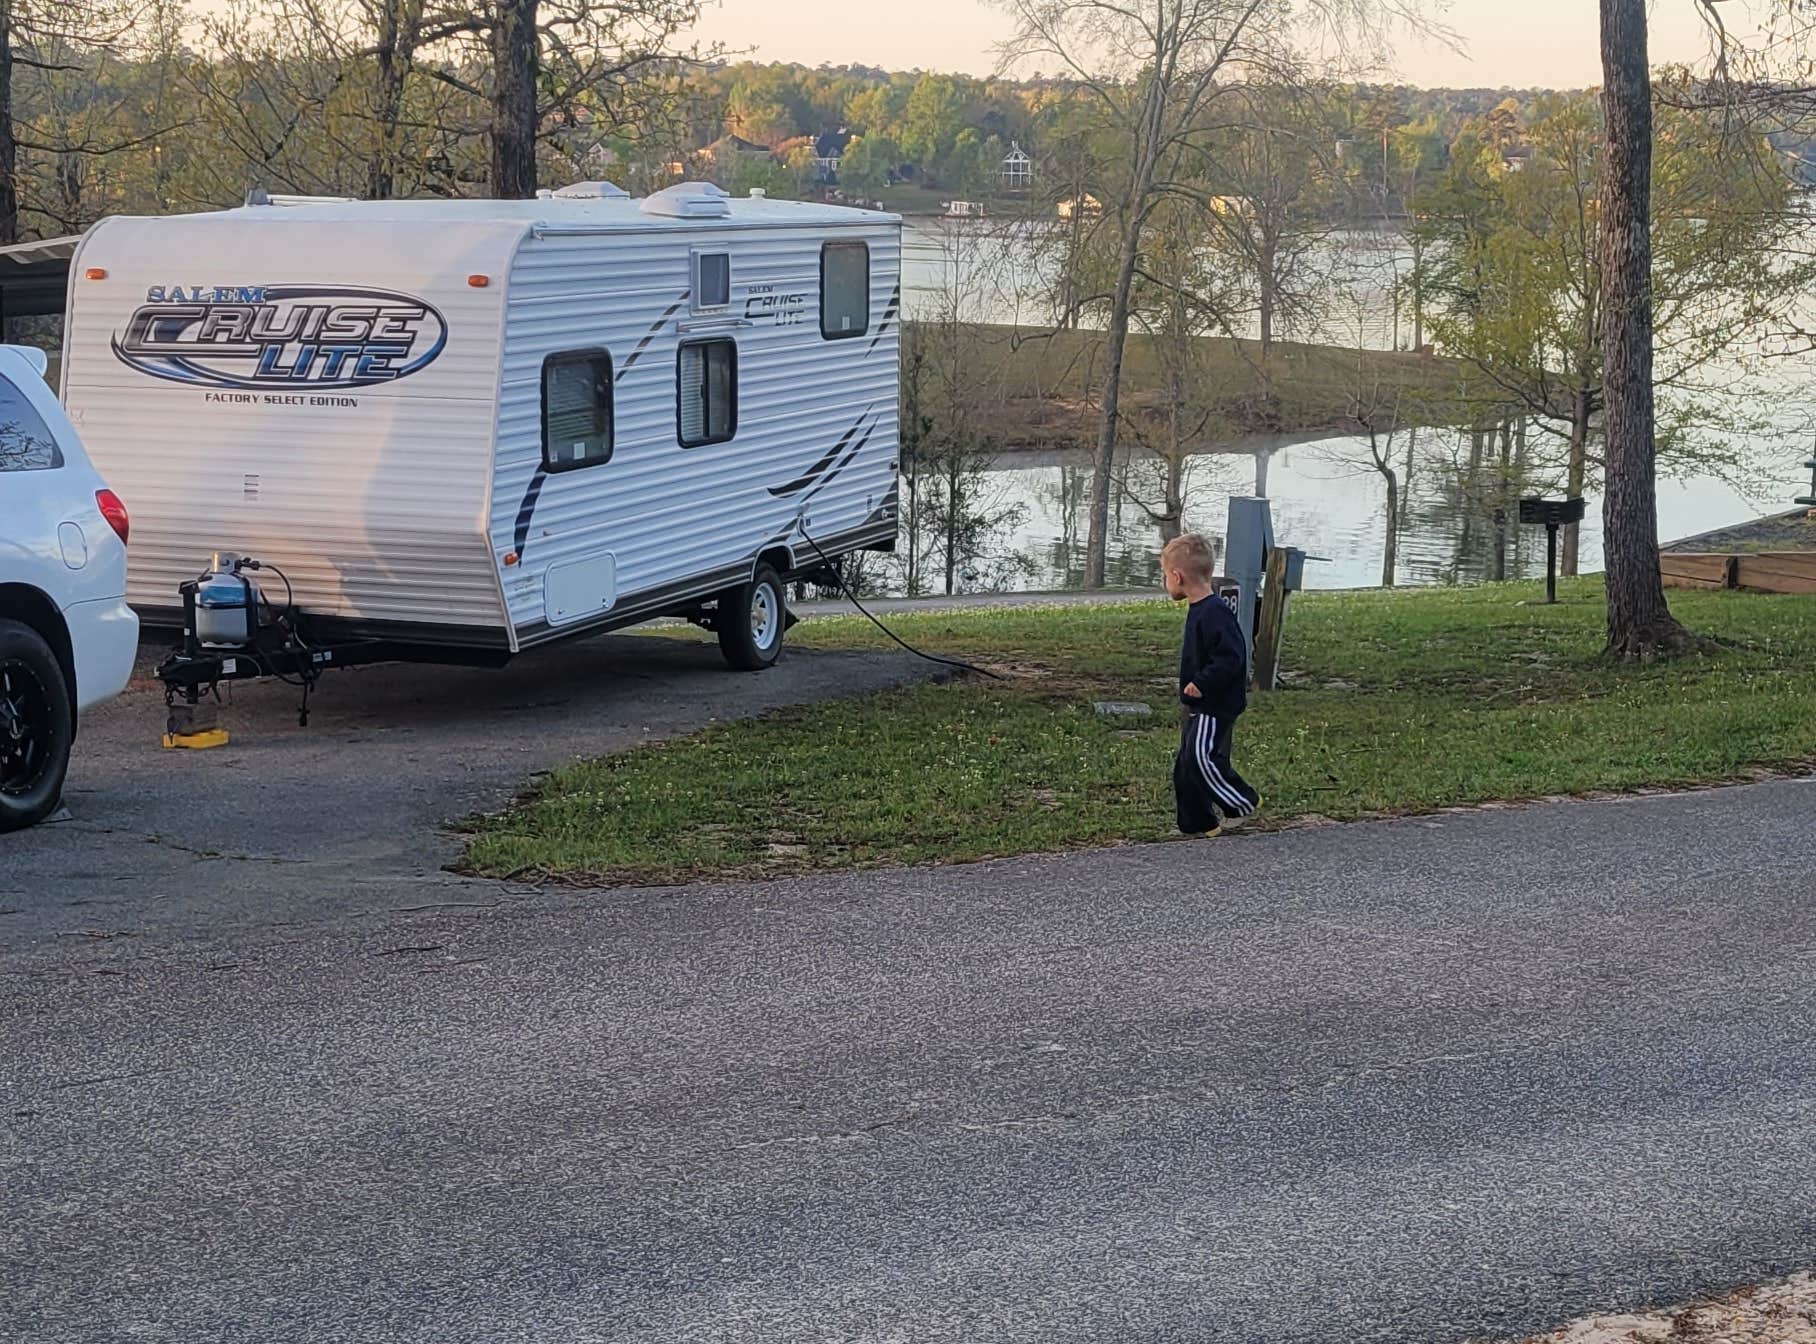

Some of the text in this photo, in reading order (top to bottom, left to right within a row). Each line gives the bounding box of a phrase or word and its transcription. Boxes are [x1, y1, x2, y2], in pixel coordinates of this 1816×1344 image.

[147, 286, 267, 303] SALEM
[121, 305, 427, 358] CRUISE
[252, 343, 408, 381] LITE
[205, 392, 359, 408] FACTORY SELECT EDITION
